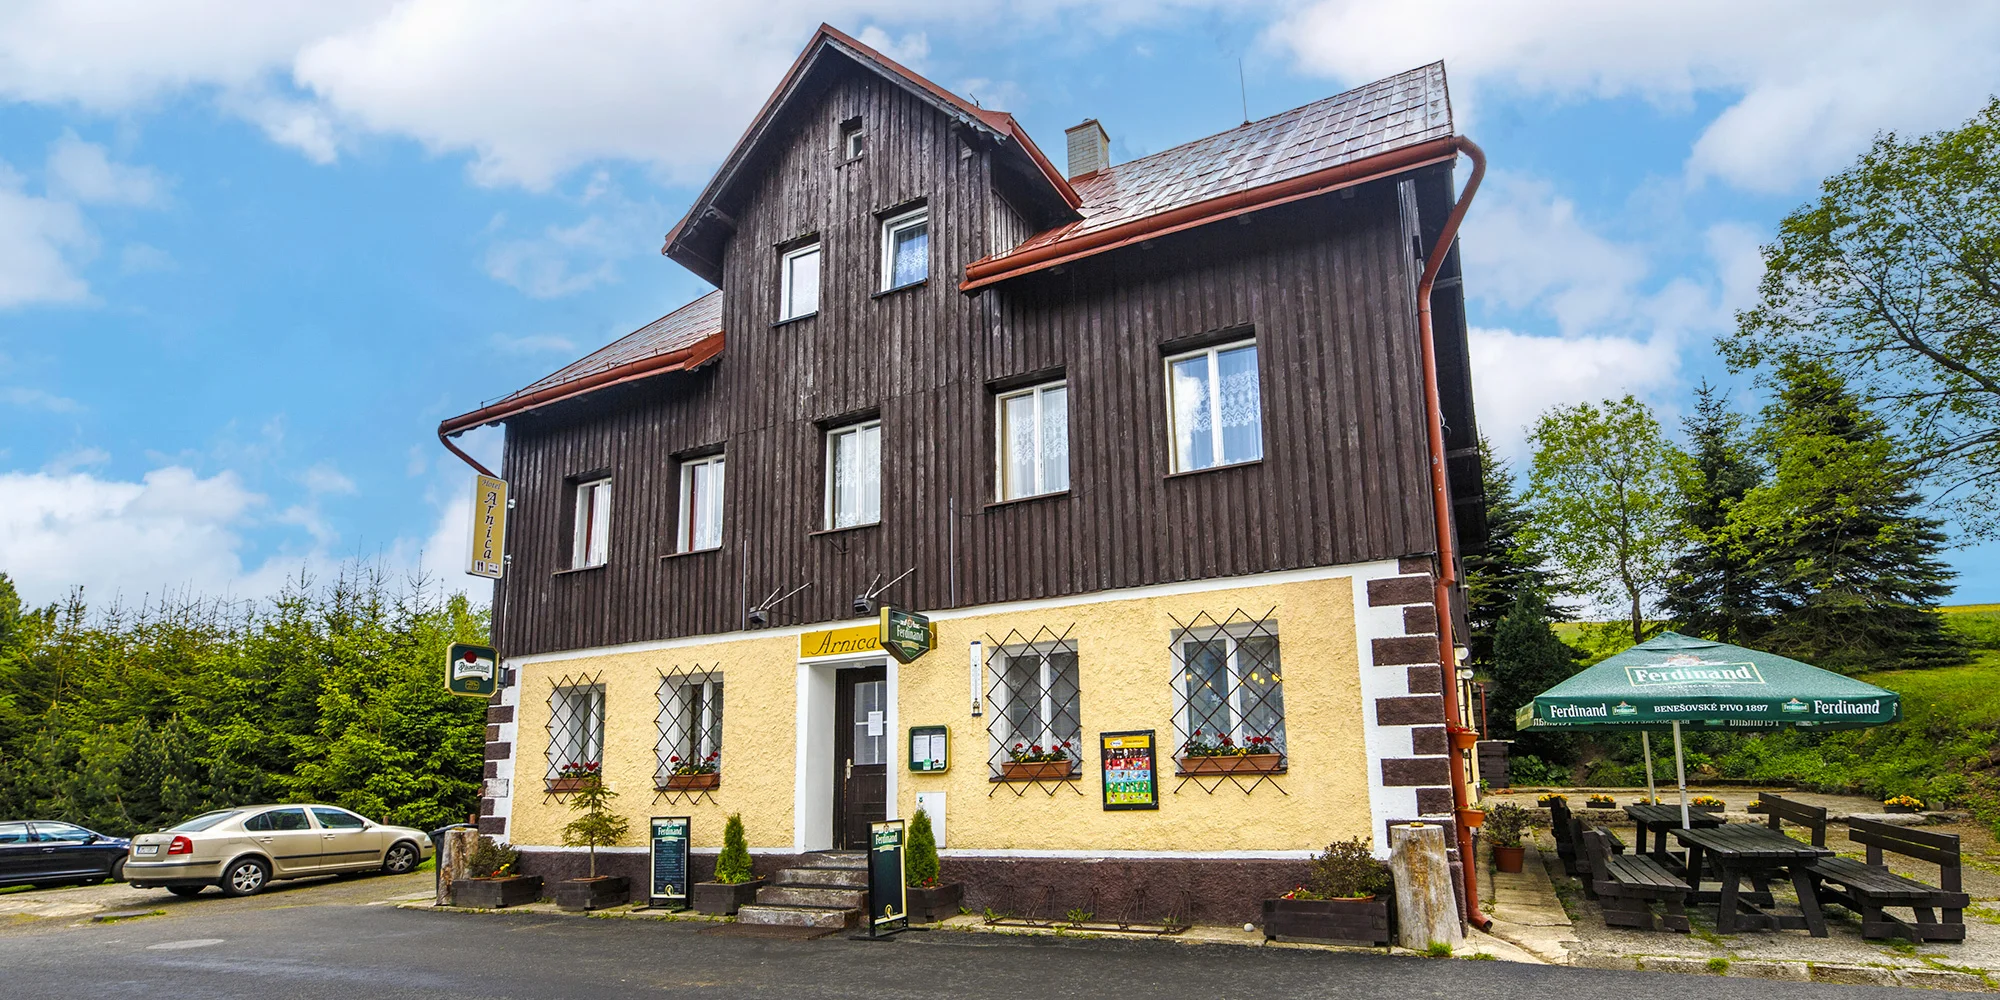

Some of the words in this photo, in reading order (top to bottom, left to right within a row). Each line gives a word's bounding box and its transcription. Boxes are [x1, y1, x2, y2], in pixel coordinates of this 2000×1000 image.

[481, 479, 501, 490] Hotel
[483, 491, 498, 560] Arnica
[896, 624, 924, 642] Ferdinand
[811, 631, 877, 655] Arnica
[1634, 666, 1753, 682] Ferdinand
[1550, 703, 1607, 718] Ferdinand
[1653, 702, 1718, 713] BENEŠOVSKÉ
[1720, 704, 1743, 712] PIVO
[1746, 704, 1769, 712] 1897
[1814, 700, 1880, 714] Ferdinand
[657, 826, 683, 835] Ferdinand
[875, 832, 898, 845] Ferdinand
